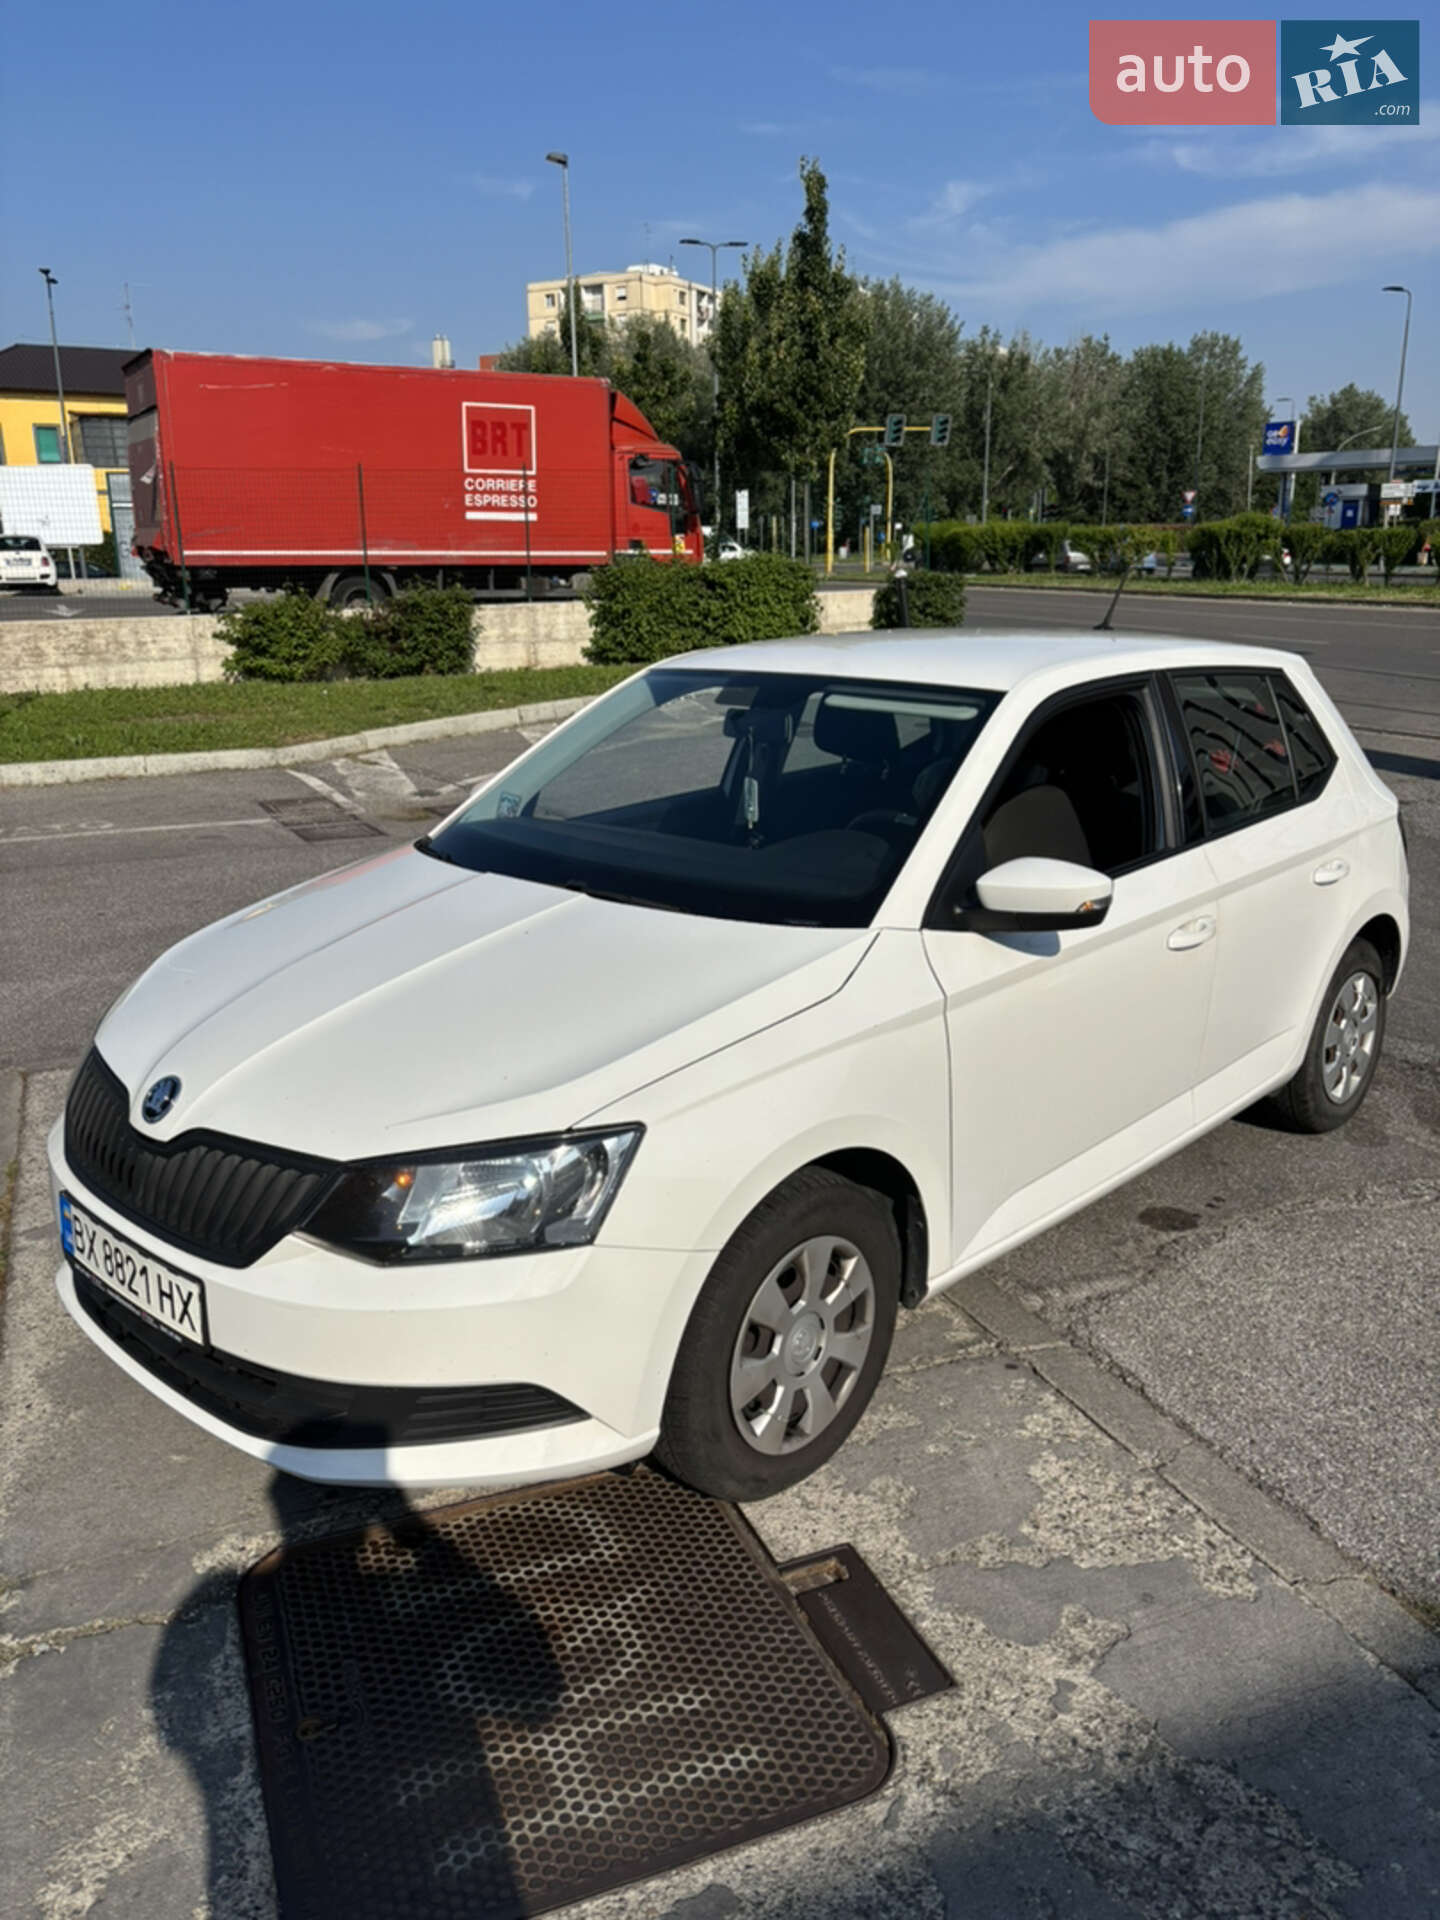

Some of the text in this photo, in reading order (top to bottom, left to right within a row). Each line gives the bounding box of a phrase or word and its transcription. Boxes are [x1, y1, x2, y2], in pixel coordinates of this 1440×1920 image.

[470, 419, 528, 457] BRT
[464, 477, 537, 492] CORRIERE
[463, 493, 538, 508] ESPRESSO
[73, 1214, 100, 1268] BX
[103, 1238, 151, 1305] 8821
[157, 1273, 197, 1333] HX
